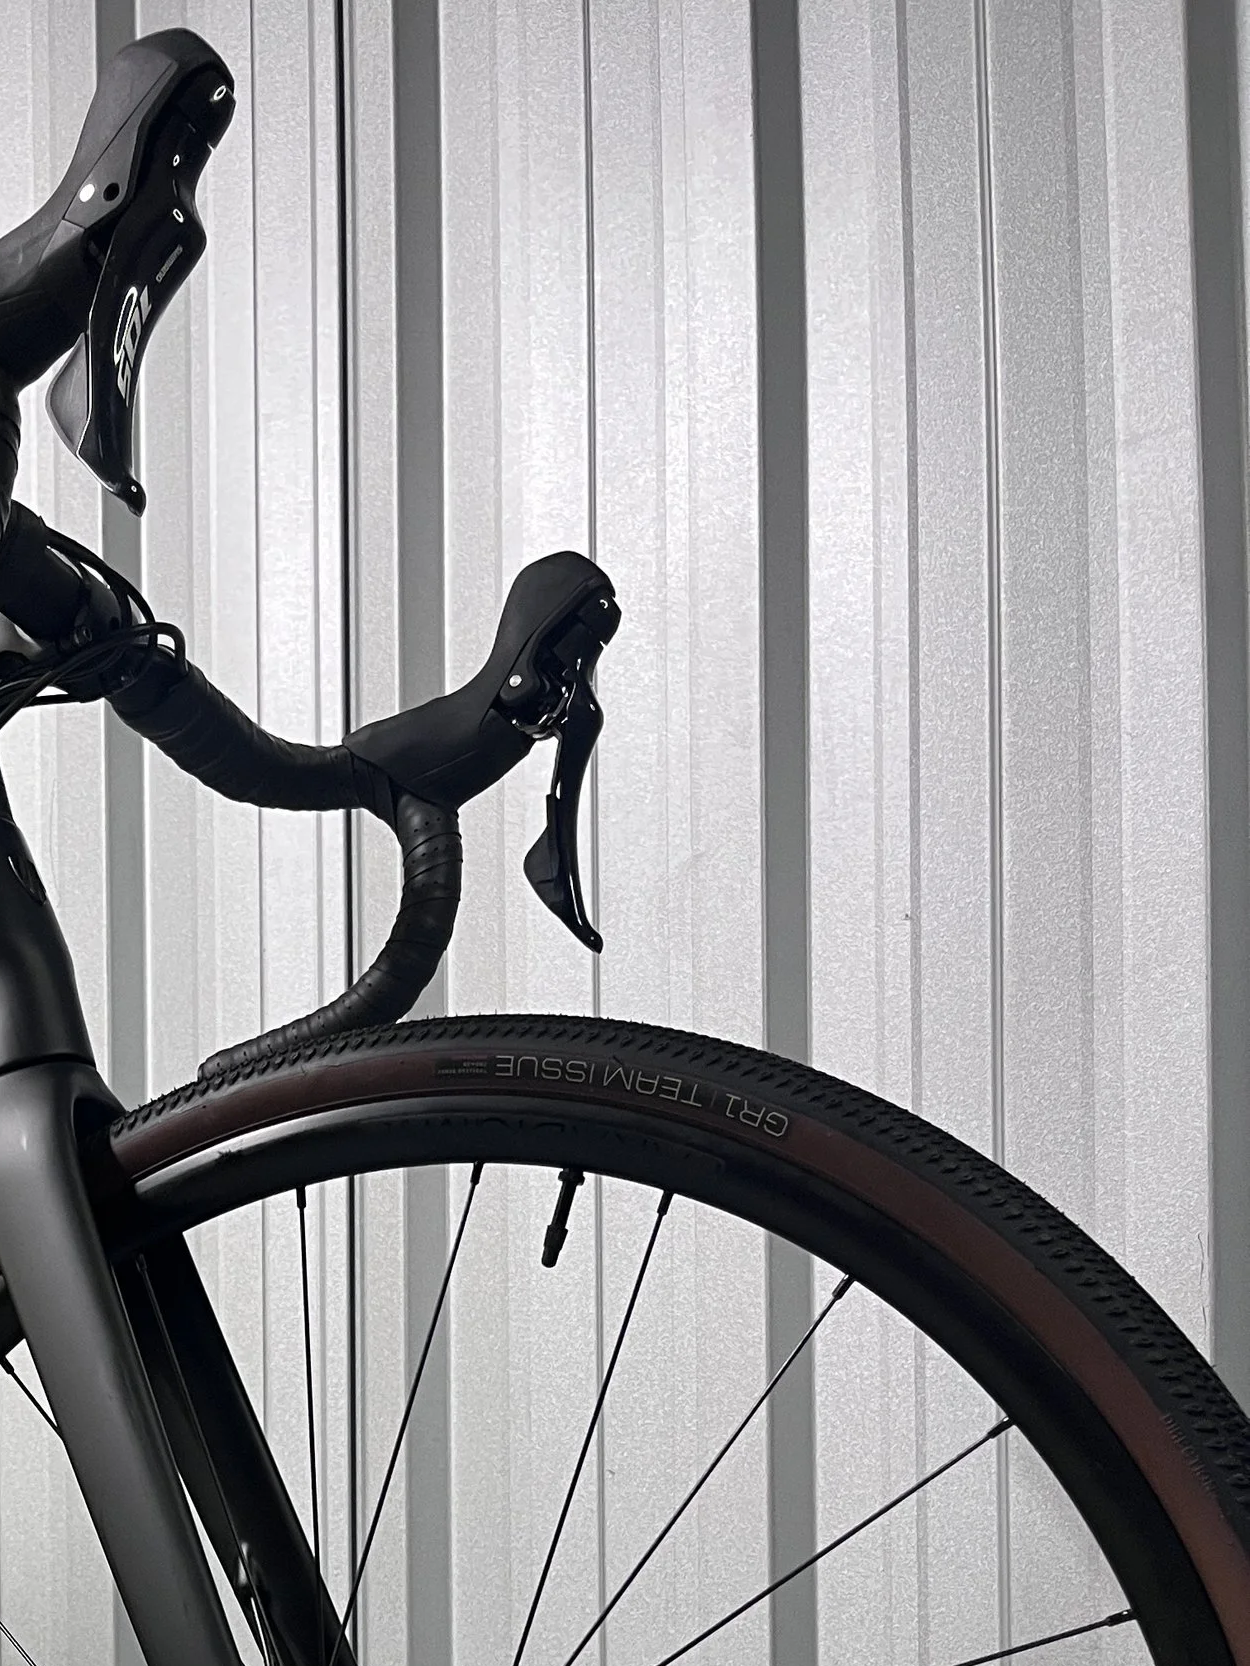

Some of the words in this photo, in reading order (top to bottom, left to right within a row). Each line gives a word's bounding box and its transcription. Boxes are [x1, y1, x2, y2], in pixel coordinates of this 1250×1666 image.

[494, 1054, 594, 1084] ISSUE
[602, 1063, 704, 1108] TEAM
[725, 1092, 789, 1138] GR1
